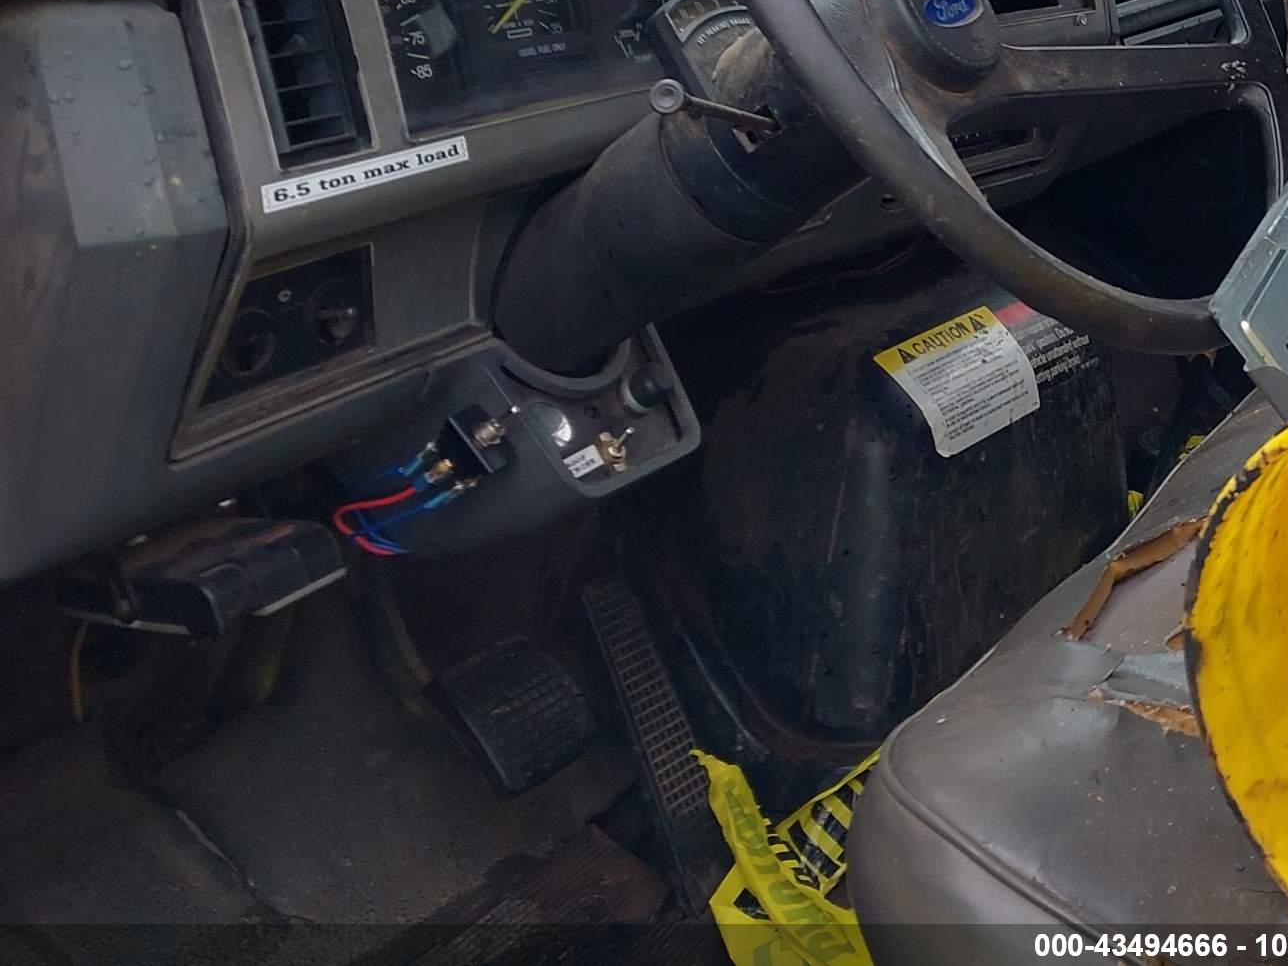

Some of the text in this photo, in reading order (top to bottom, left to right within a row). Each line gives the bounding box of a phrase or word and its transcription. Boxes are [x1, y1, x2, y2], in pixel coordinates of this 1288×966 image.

[409, 31, 426, 46] 75
[416, 63, 434, 79] 85
[273, 143, 461, 203] 6.5 ton max load
[912, 320, 972, 355] CAUTION
